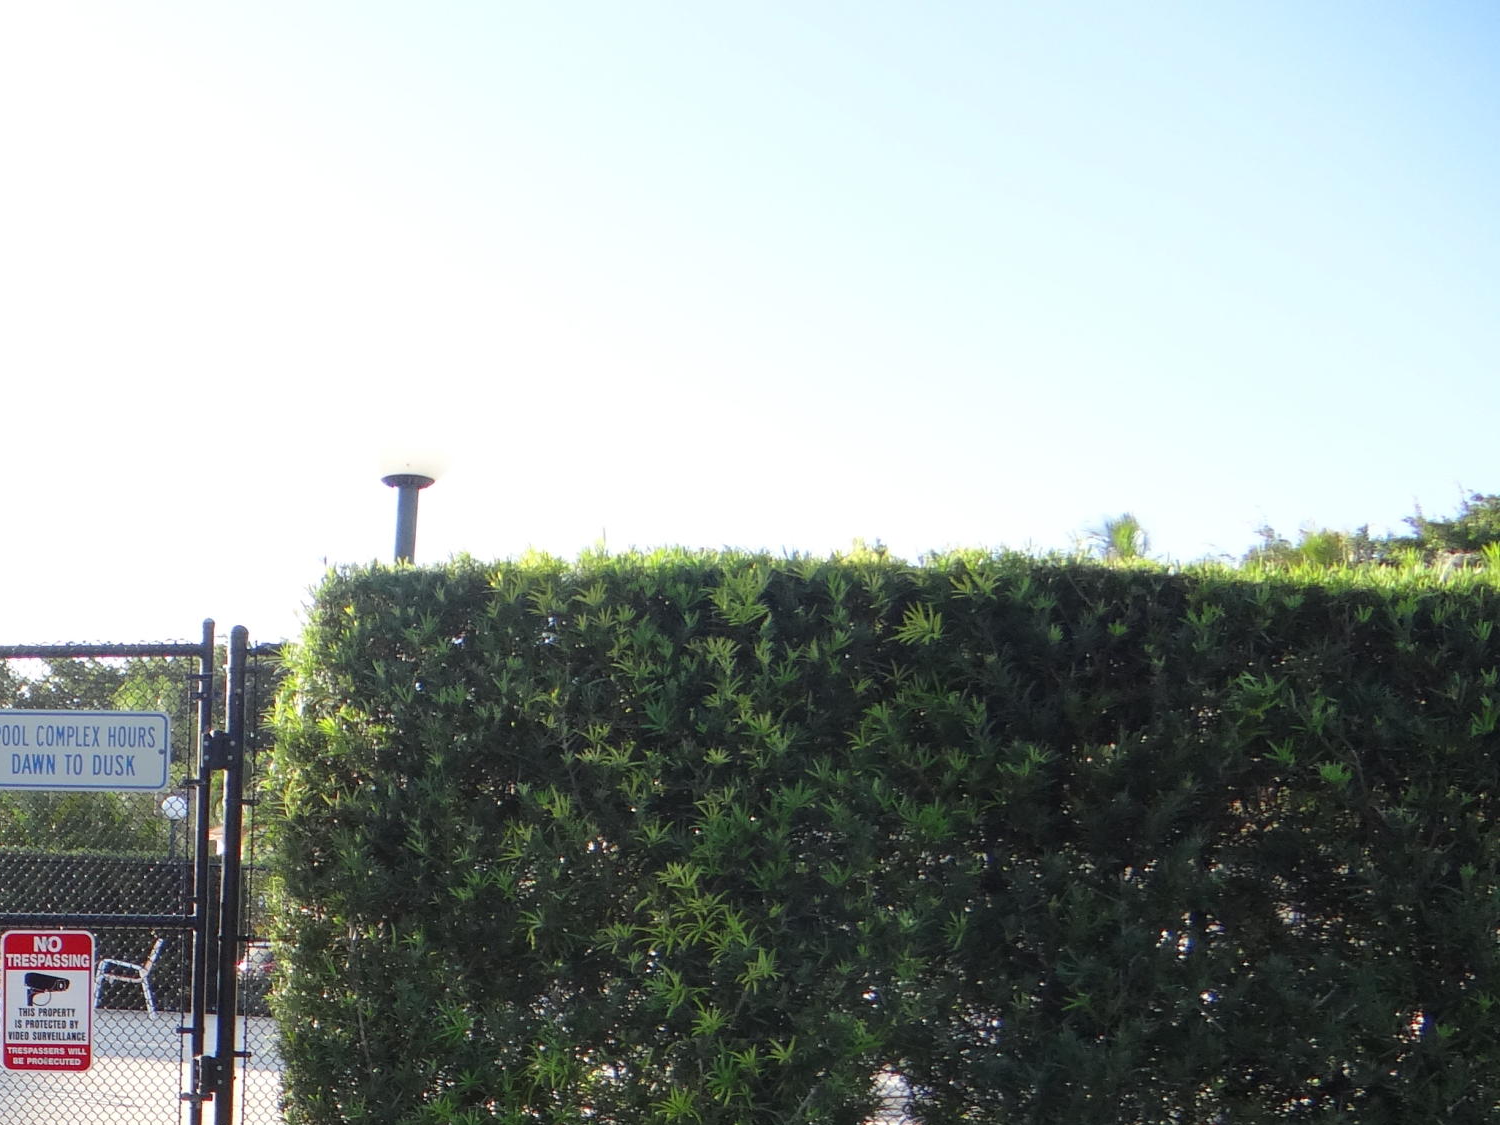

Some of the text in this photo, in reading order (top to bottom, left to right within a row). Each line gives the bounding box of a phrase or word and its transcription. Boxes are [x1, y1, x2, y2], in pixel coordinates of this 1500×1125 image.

[37, 726, 100, 747] COMPLEX
[109, 727, 155, 748] HOURS
[12, 754, 135, 776] DAWN TO DUSK
[34, 936, 62, 952] NO
[6, 954, 90, 967] TRESPASSING
[19, 1008, 75, 1017] THIS PROPERTY
[26, 1020, 66, 1029] PROTECTED
[70, 1021, 79, 1029] BY
[8, 1032, 86, 1041] VIDEO SURVEILLANCE
